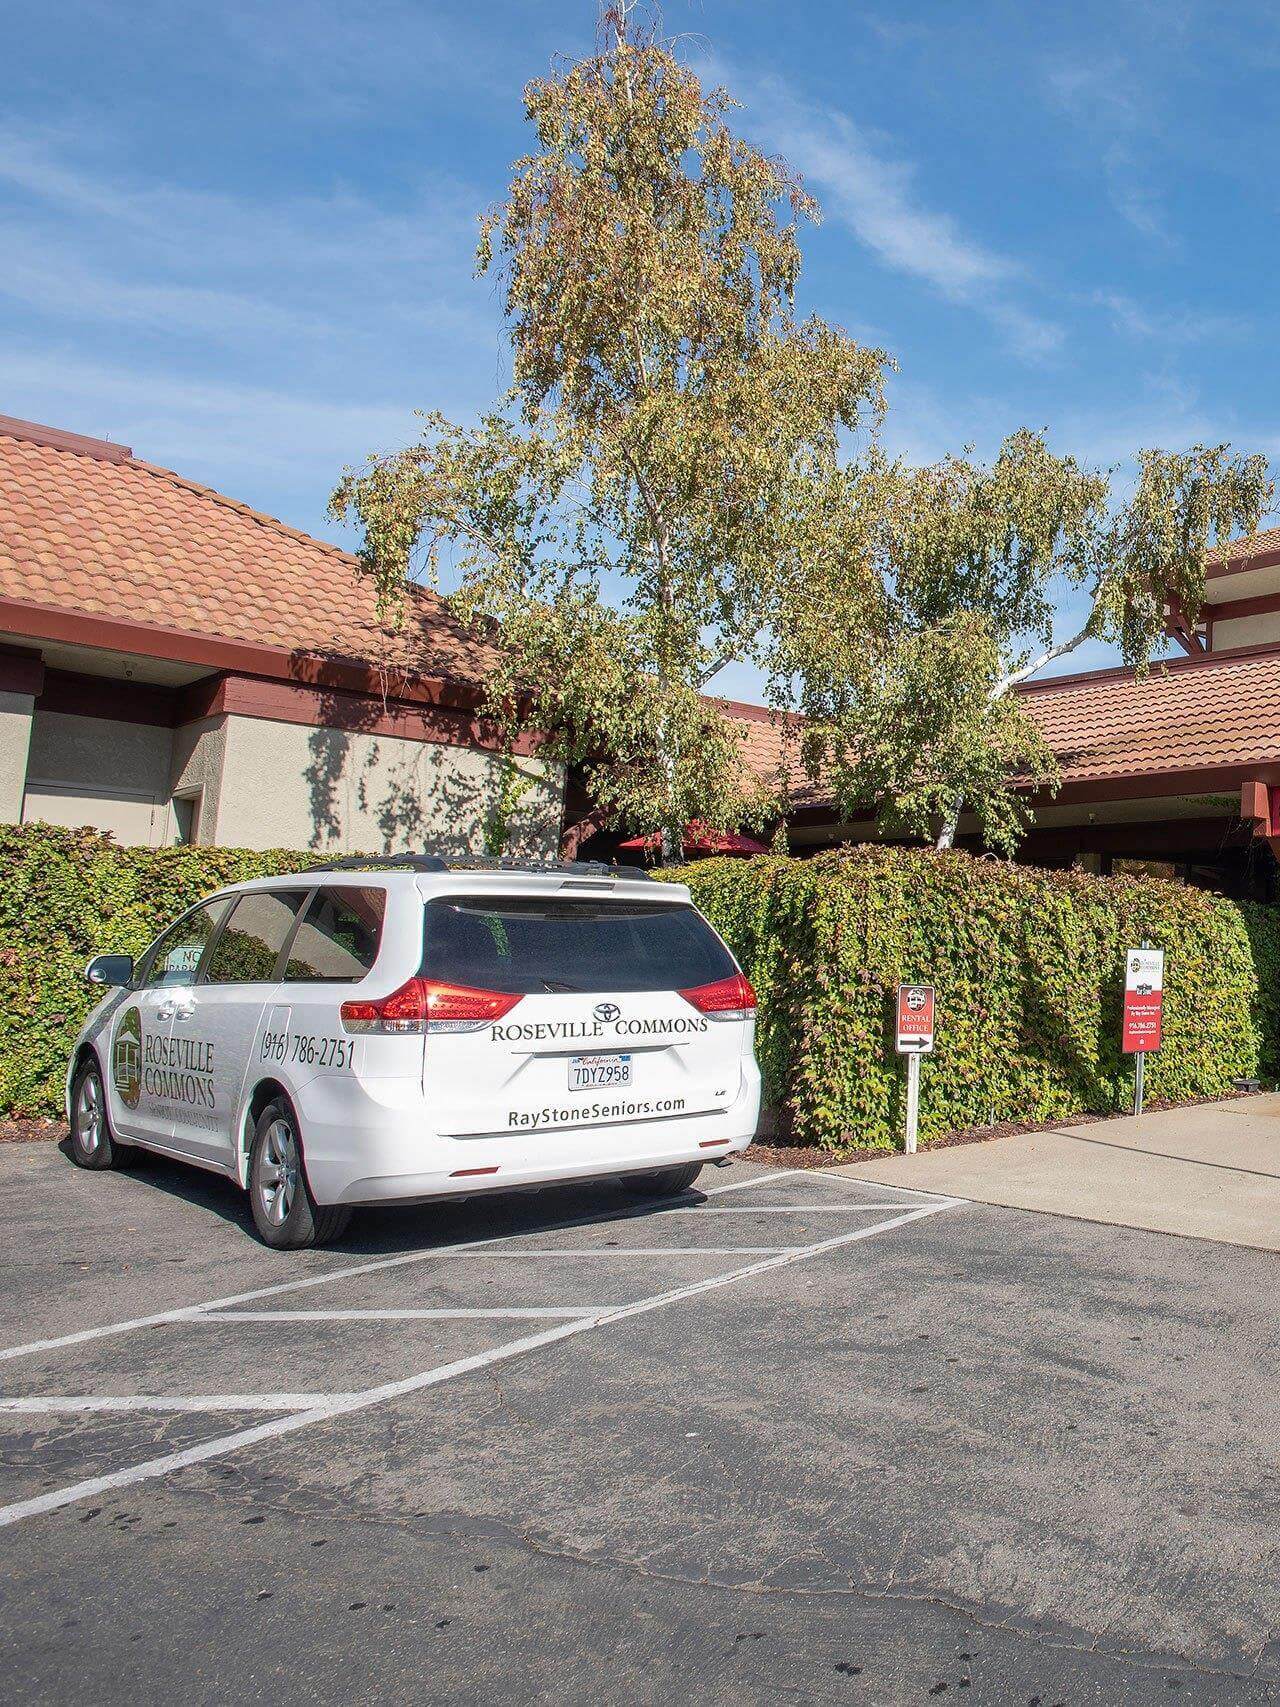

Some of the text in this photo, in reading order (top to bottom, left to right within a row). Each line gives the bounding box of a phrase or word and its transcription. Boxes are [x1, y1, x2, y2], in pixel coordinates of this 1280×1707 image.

[491, 1018, 708, 1041] ROSEVILLE COMMONS
[145, 1035, 215, 1074] ROSEVILLE
[260, 1031, 355, 1068] (916) 786-2751
[145, 1068, 216, 1109] COMMONS
[574, 1066, 629, 1084] 7DYZ958
[508, 1098, 686, 1128] RayStoneSeniors.com
